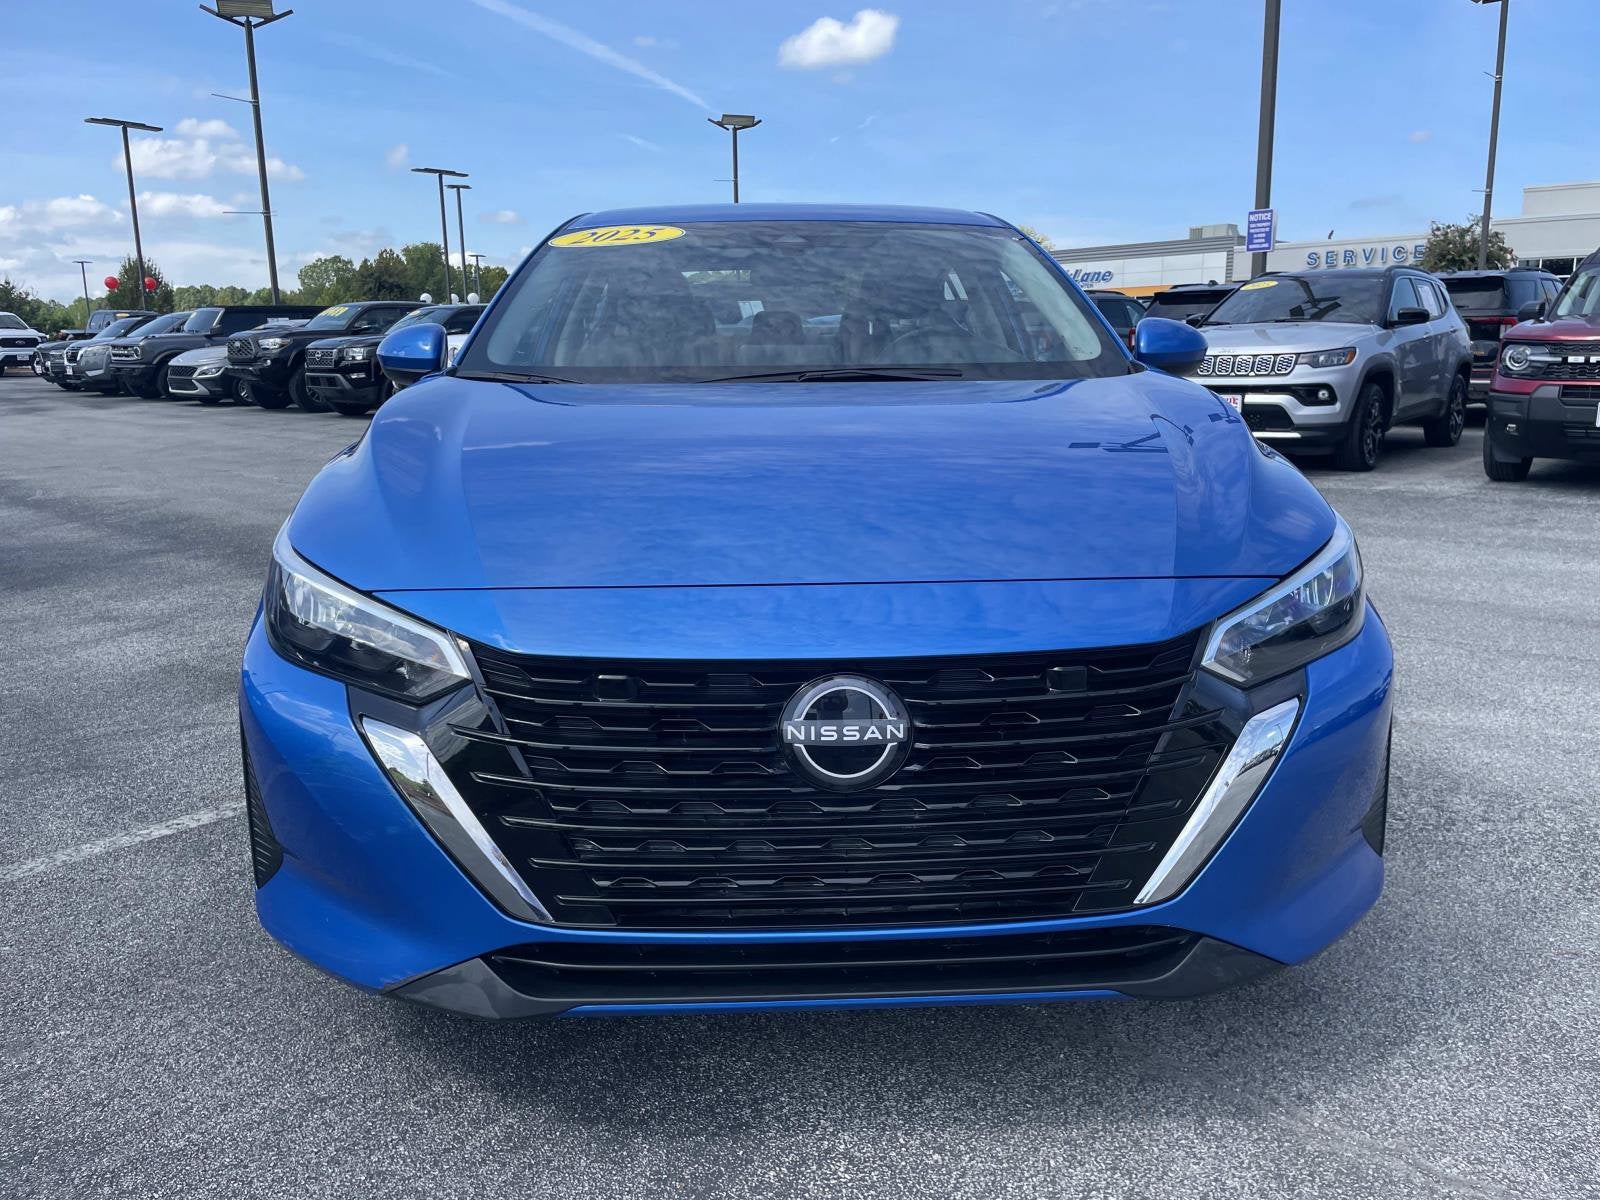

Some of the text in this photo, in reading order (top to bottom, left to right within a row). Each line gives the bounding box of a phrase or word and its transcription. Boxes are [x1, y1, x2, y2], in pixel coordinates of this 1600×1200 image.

[1249, 212, 1272, 222] NOTICE
[569, 228, 664, 245] 2025
[1306, 245, 1426, 267] SERVICE
[1073, 269, 1112, 283] Lane
[787, 723, 904, 741] NISSAN
